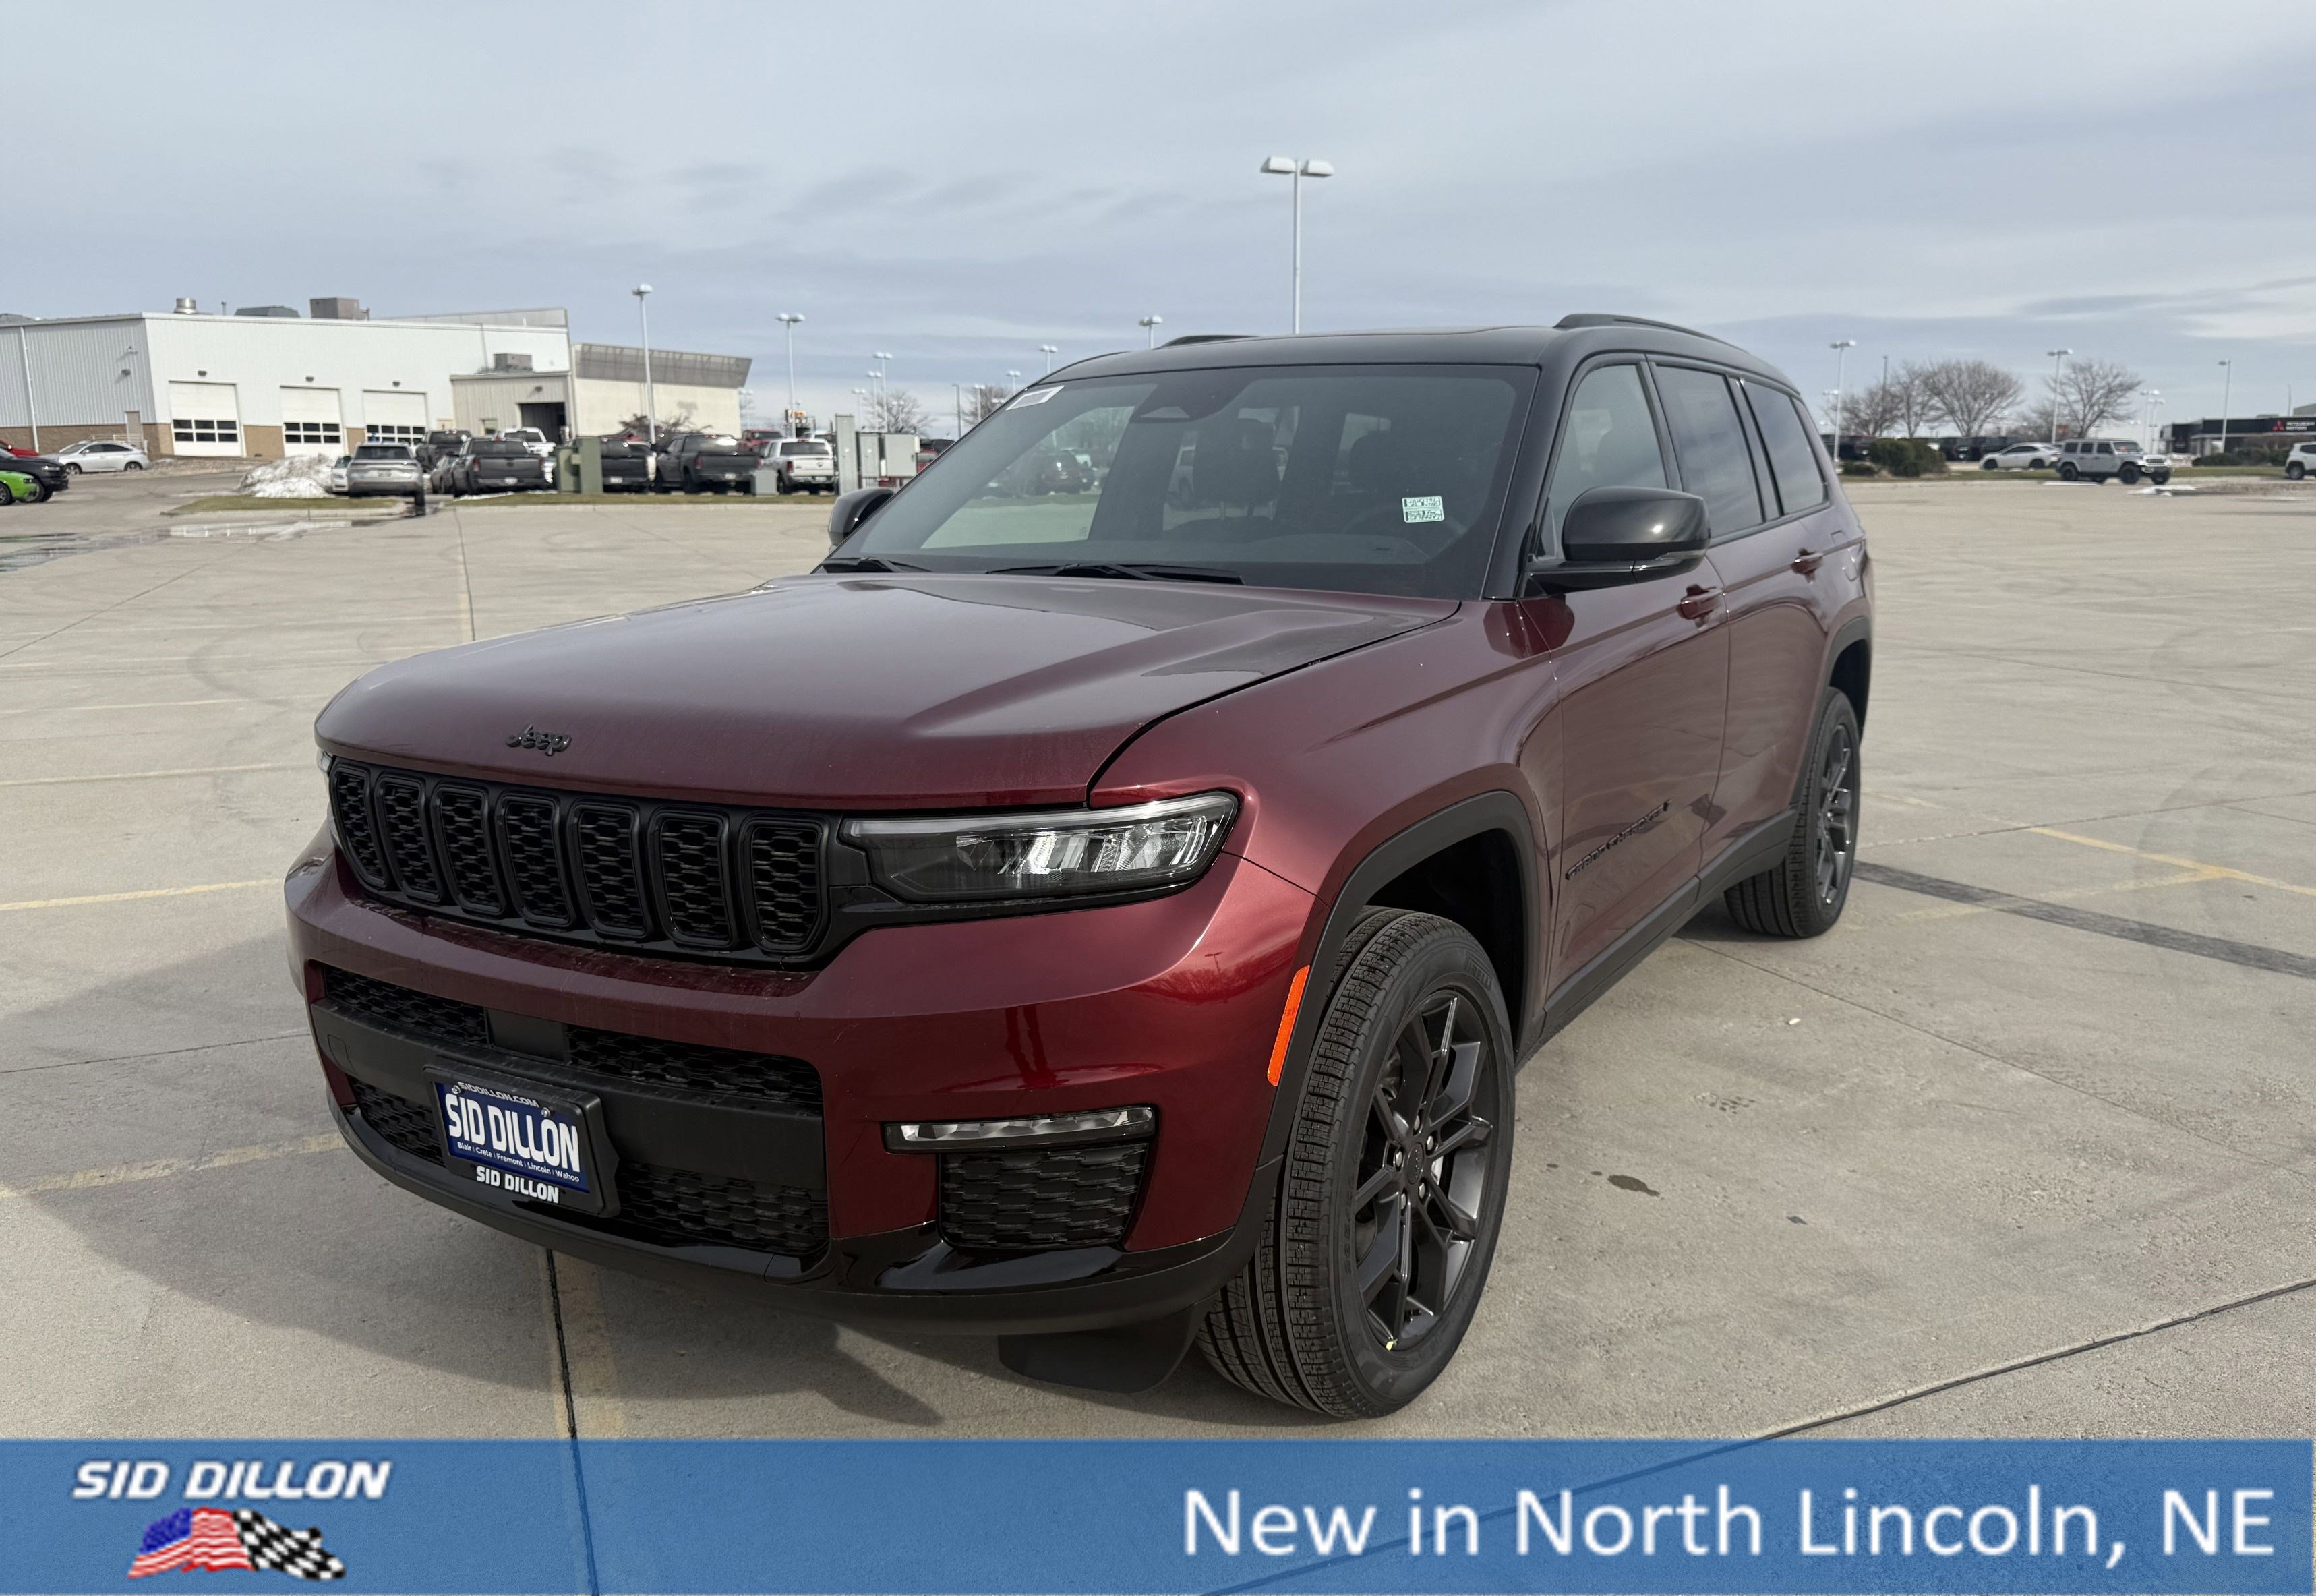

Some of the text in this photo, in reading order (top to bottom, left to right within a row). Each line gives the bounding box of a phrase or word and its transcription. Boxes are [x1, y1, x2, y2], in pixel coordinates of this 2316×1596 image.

[506, 724, 572, 756] Jeep
[458, 1082, 539, 1108] SIDDILLON.COM
[445, 1093, 581, 1173] SID DILLON
[457, 1142, 579, 1183] Blair Crete Fremont Lincoln Wahoo
[476, 1166, 559, 1204] SID DILLON
